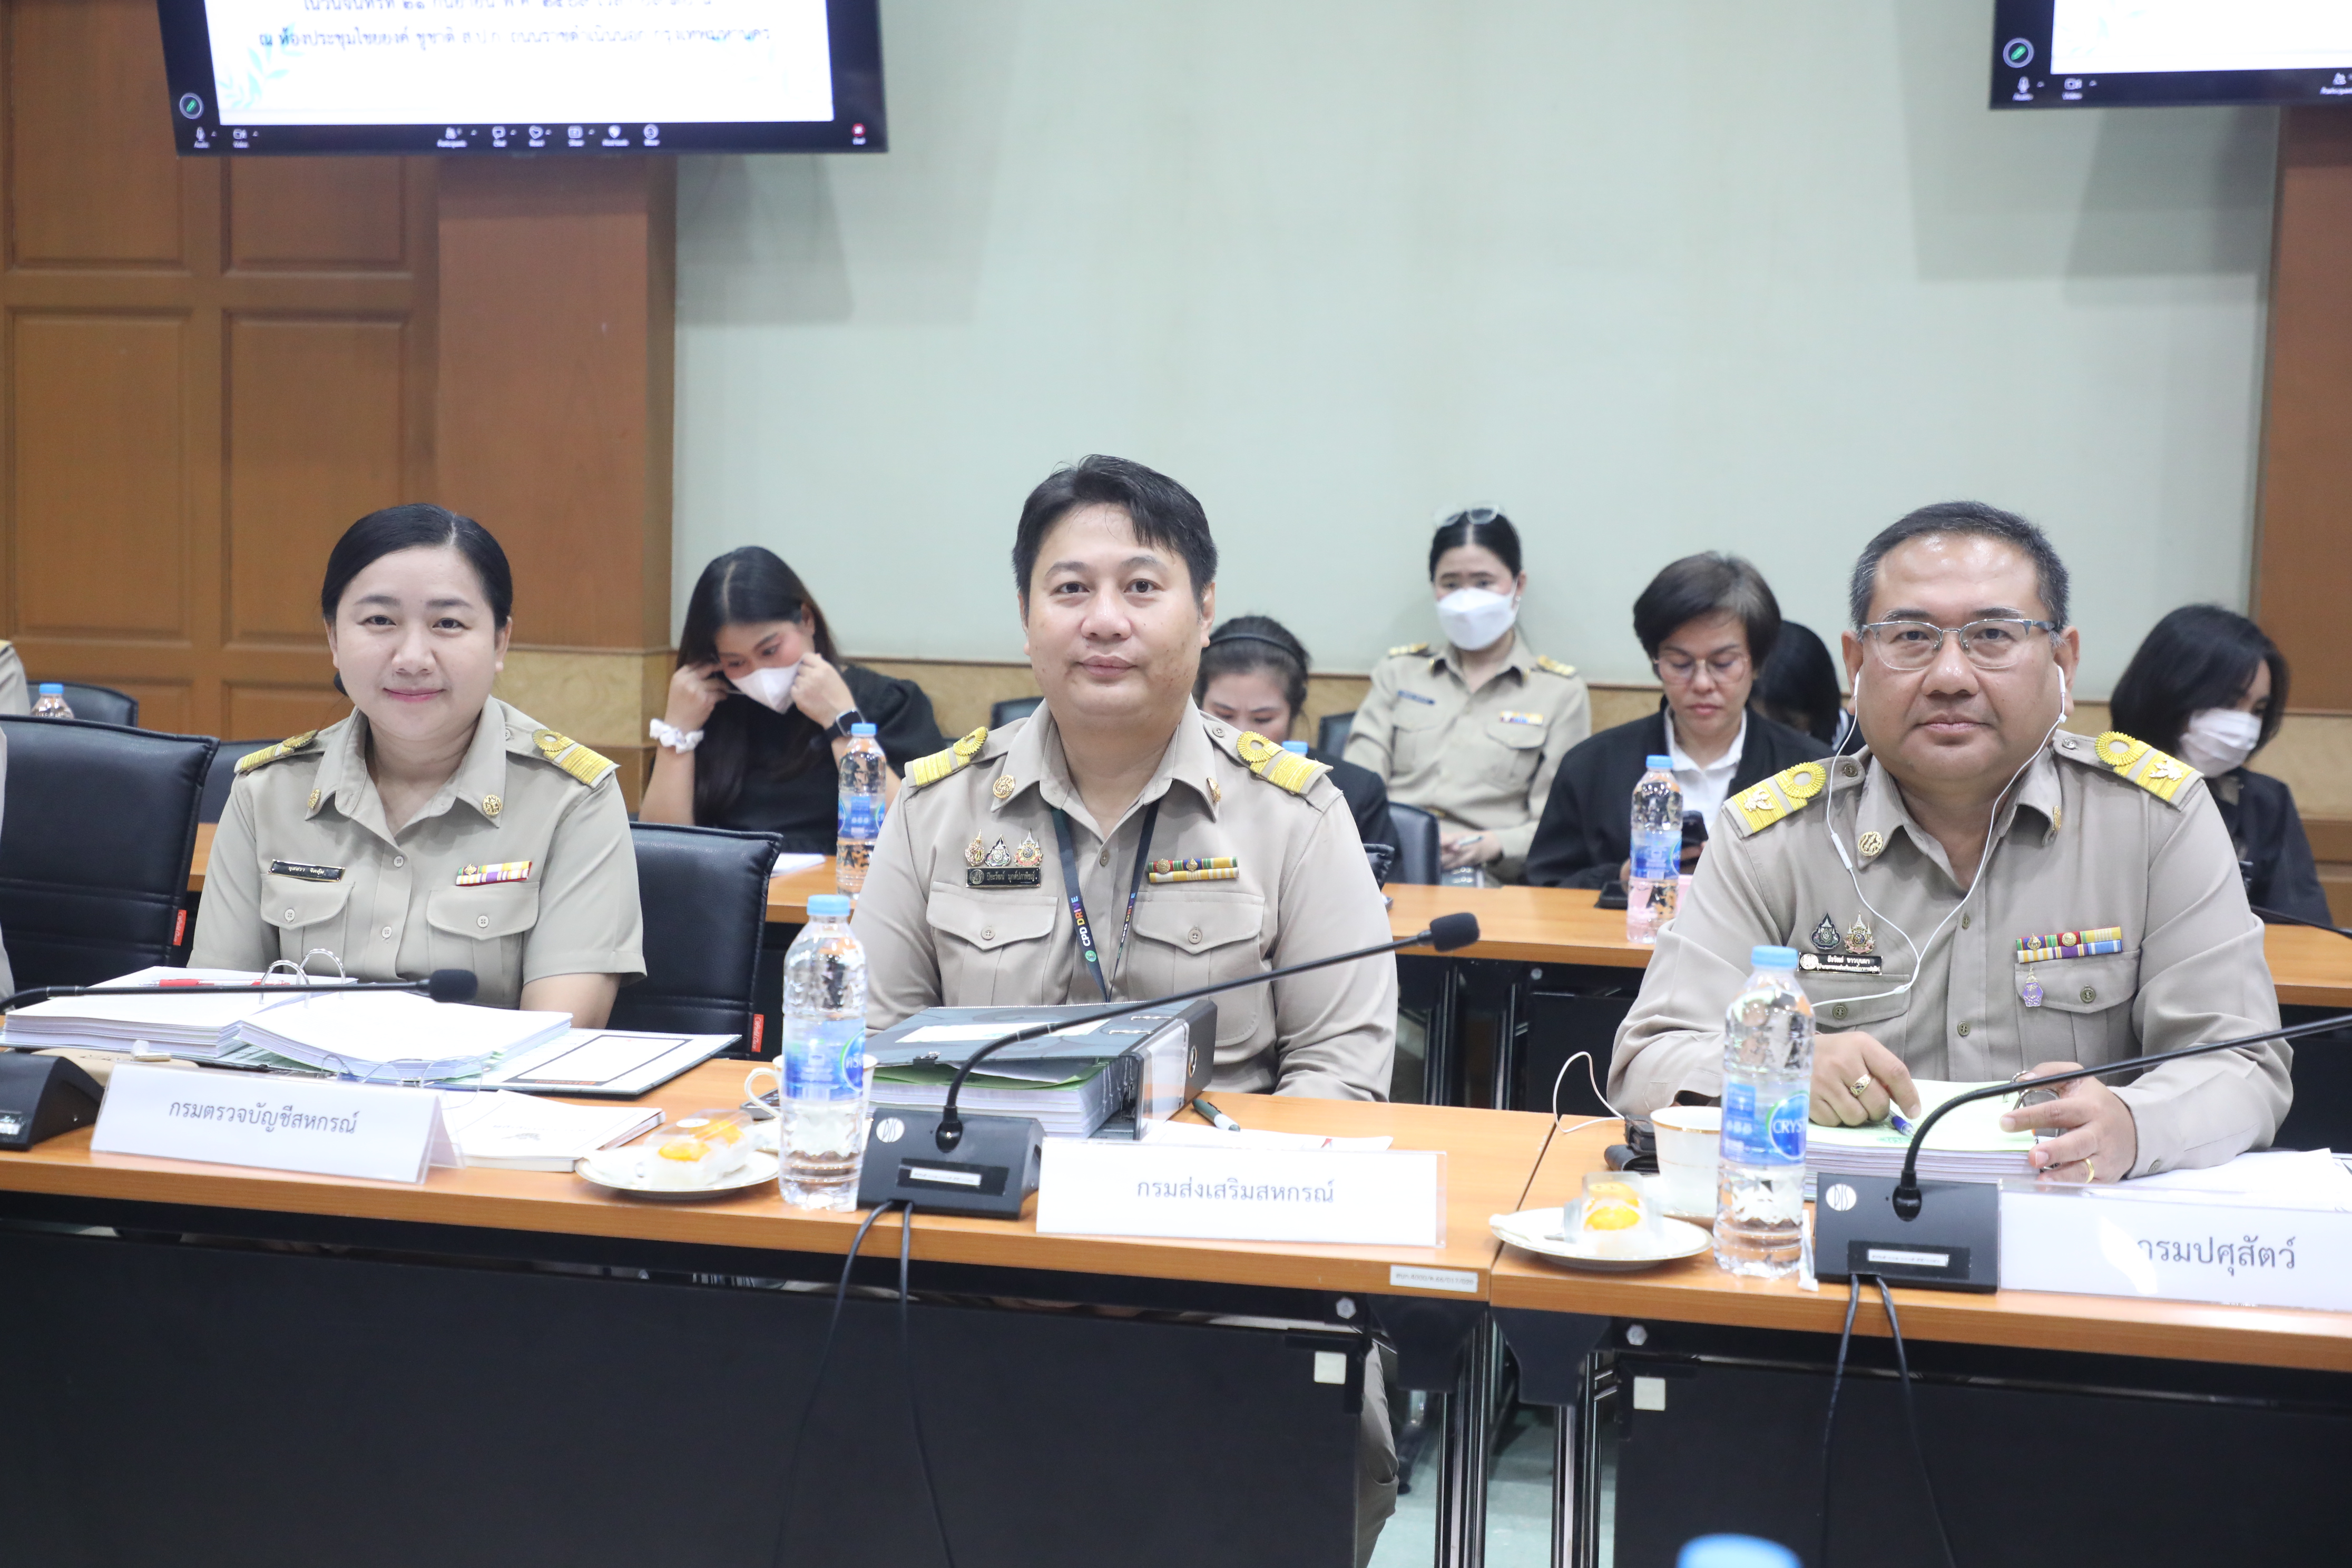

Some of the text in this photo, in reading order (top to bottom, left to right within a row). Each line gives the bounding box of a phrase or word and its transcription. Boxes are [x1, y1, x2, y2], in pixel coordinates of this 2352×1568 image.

[1071, 896, 1091, 947] CPD DRIVE
[169, 1102, 360, 1134] กรมตรวจบัญชีสหกรณ์
[1137, 1177, 1335, 1203] กรมส่งเสริมสหกรณ์
[2137, 1235, 2296, 1277] กรมปศุสัตว์
